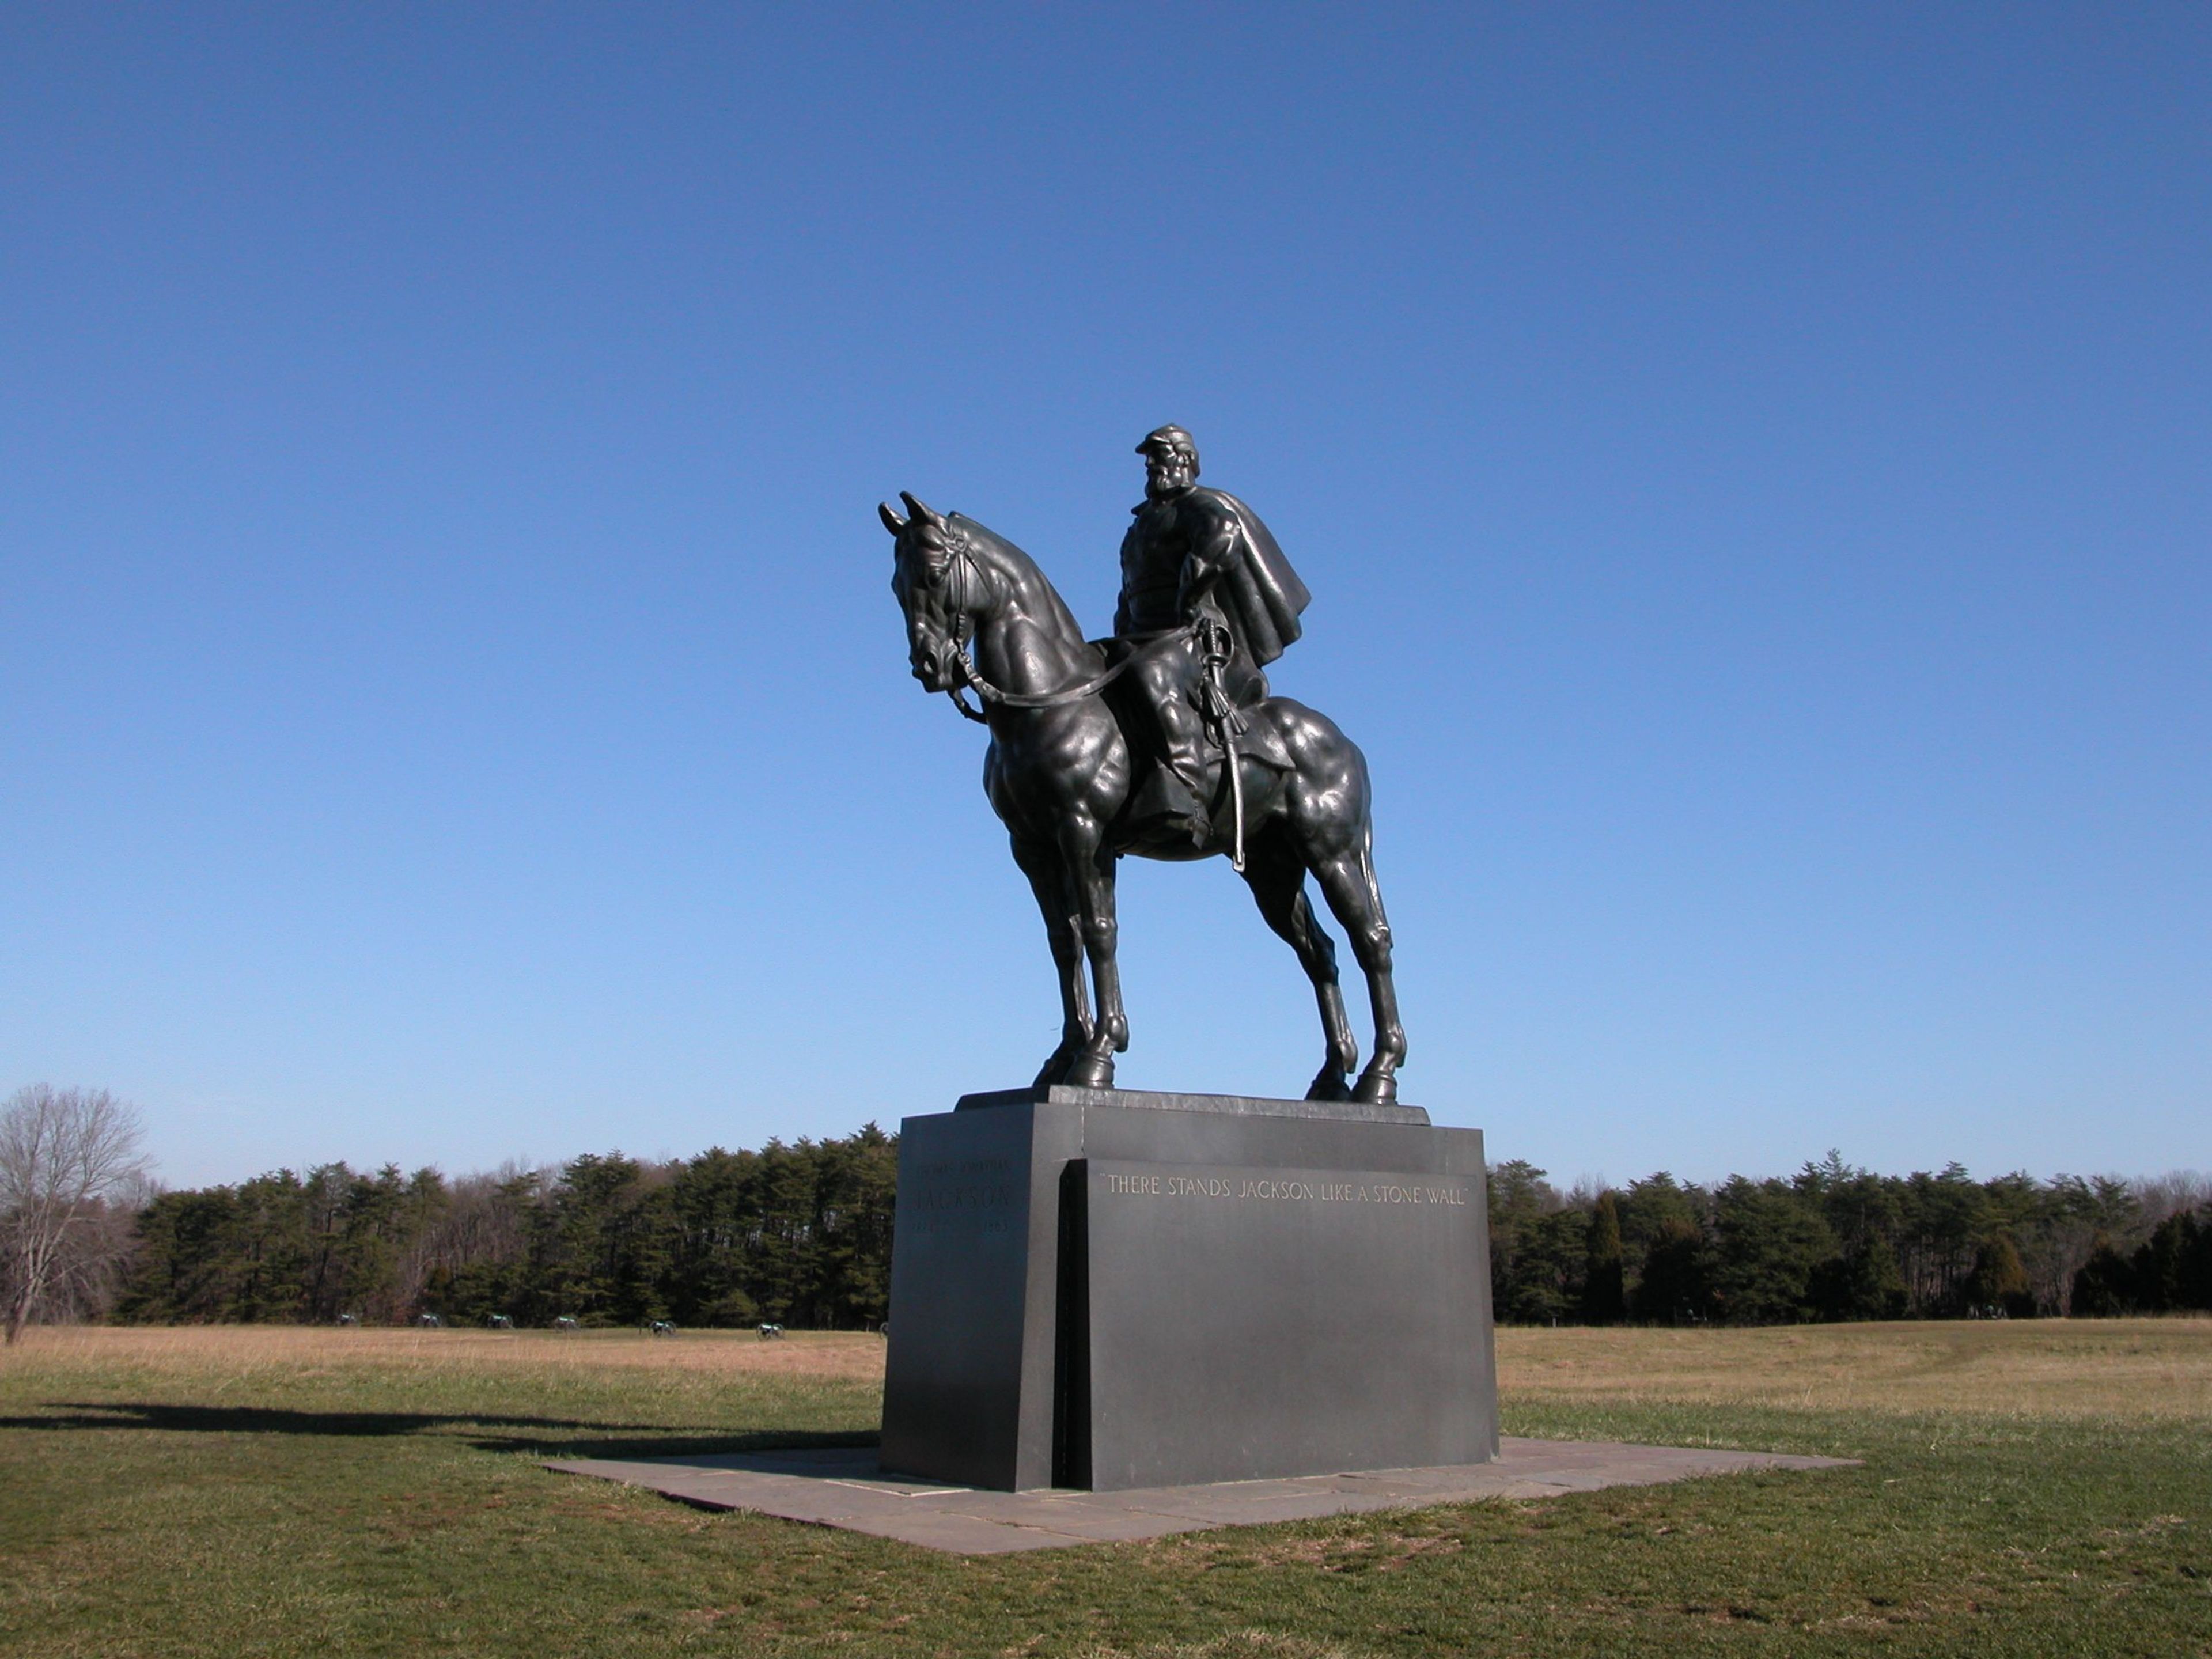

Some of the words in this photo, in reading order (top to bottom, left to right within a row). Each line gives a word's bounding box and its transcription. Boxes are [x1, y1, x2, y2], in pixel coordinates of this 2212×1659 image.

[913, 1185, 1010, 1211] JACKSON
[1168, 1177, 1230, 1197] STANDS
[1238, 1180, 1313, 1200] JACKSON
[1321, 1184, 1352, 1202] LIKE
[1358, 1186, 1369, 1202] A
[1373, 1185, 1422, 1203] STONE
